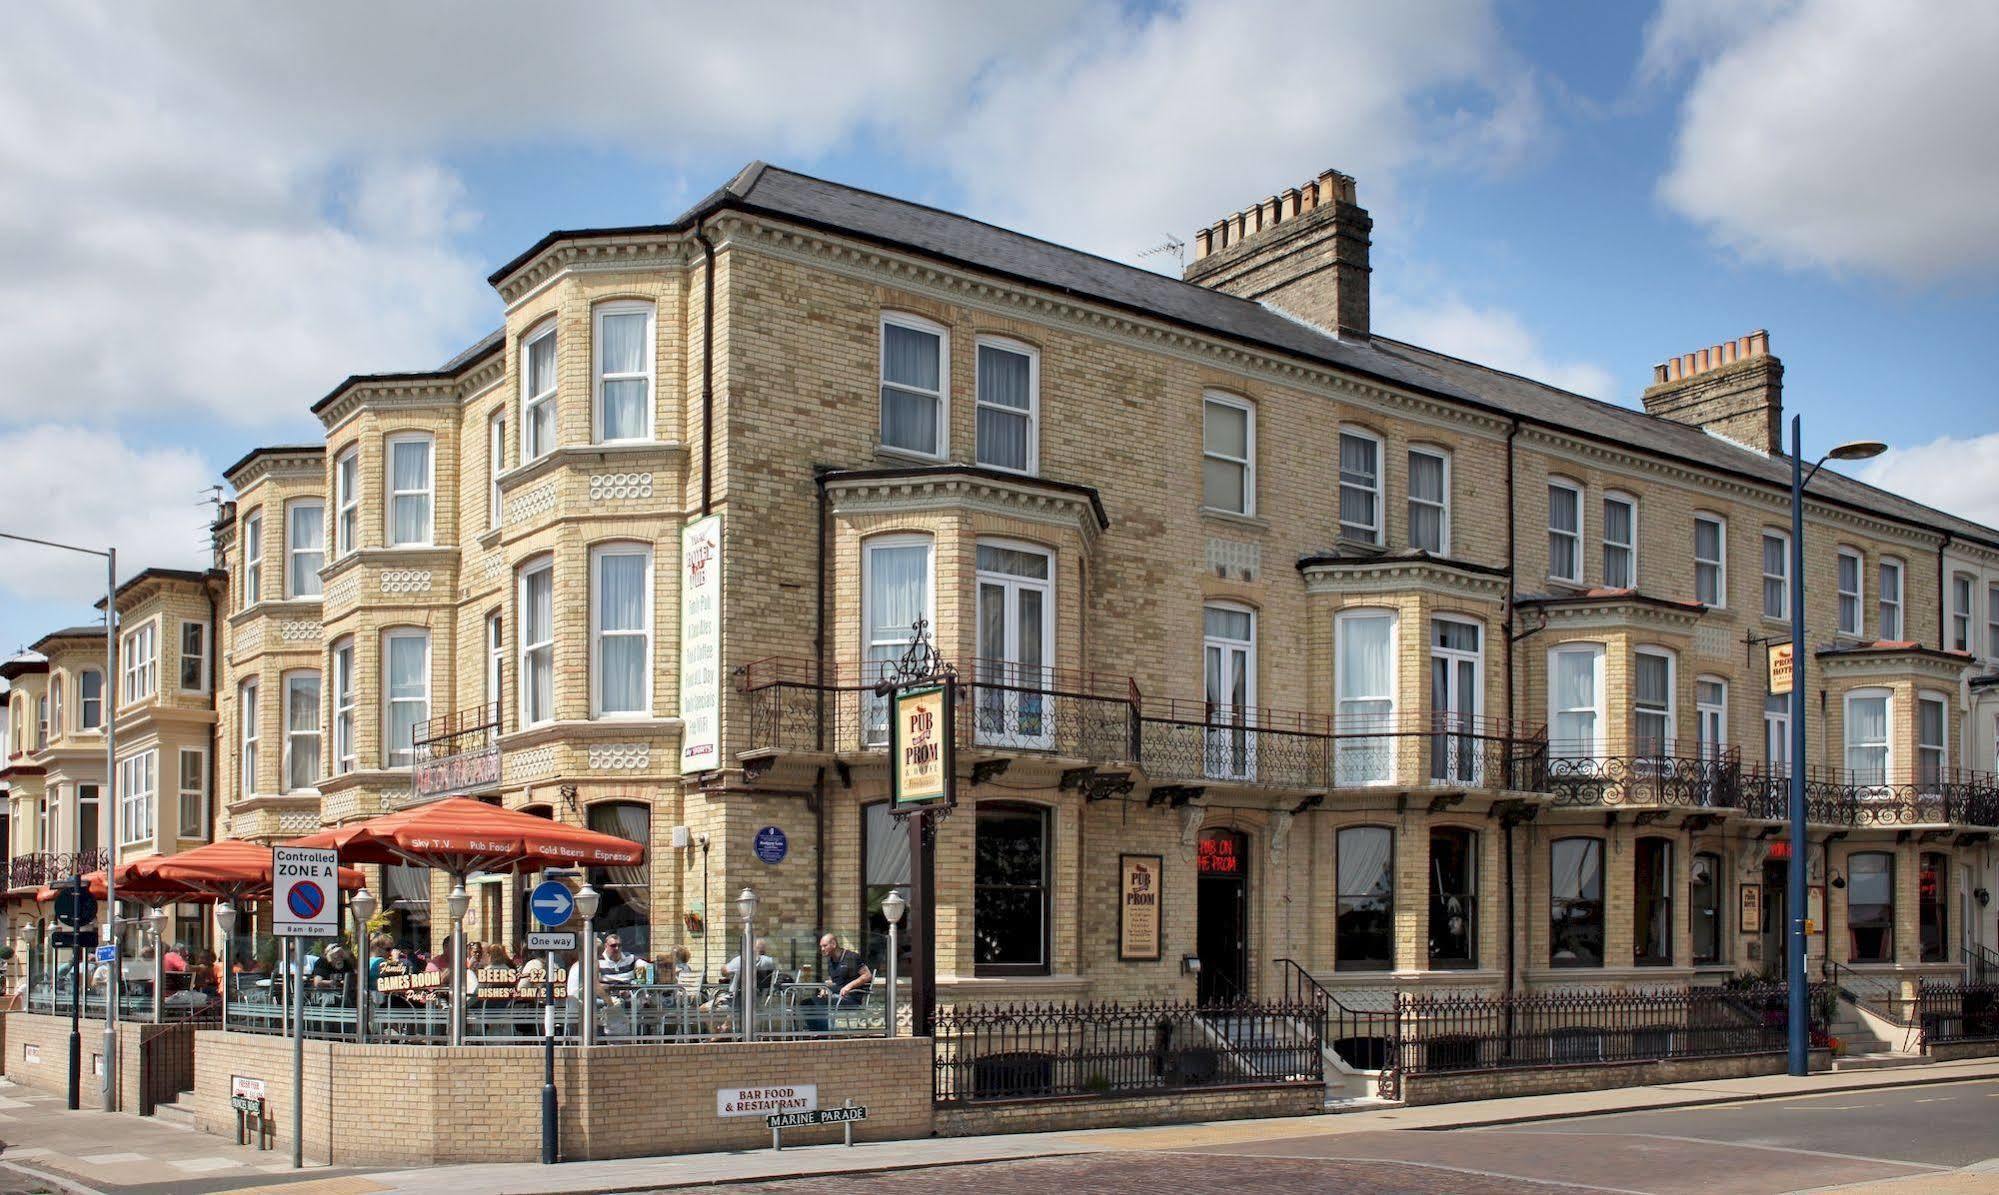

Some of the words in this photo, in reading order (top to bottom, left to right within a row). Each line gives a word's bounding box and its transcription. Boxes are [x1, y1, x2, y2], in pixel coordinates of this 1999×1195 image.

[1774, 658, 1793, 667] PRO
[911, 712, 933, 734] PUB
[906, 742, 938, 765] PROM
[412, 839, 429, 849] Sky
[470, 841, 485, 851] Pub
[489, 842, 511, 852] Food
[277, 850, 335, 863] Controlled
[539, 845, 558, 855] Cold
[560, 847, 585, 857] Beers
[595, 849, 632, 861] Espresso
[279, 864, 319, 877] ZONE
[324, 866, 333, 877] A
[1132, 872, 1151, 886] PUB
[1127, 892, 1155, 906] PROM
[531, 936, 550, 945] One
[553, 938, 572, 946] way
[379, 961, 407, 975] Family
[377, 974, 410, 992] GAMES
[410, 971, 441, 989] ROOM
[477, 968, 517, 983] BEERS
[478, 987, 510, 998] DISHES
[520, 987, 538, 998] DAY
[739, 1089, 761, 1100] BAR
[765, 1088, 795, 1098] FOOD
[725, 1102, 734, 1112] &
[770, 1112, 815, 1126] MARINE
[821, 1107, 863, 1122] PARADE
